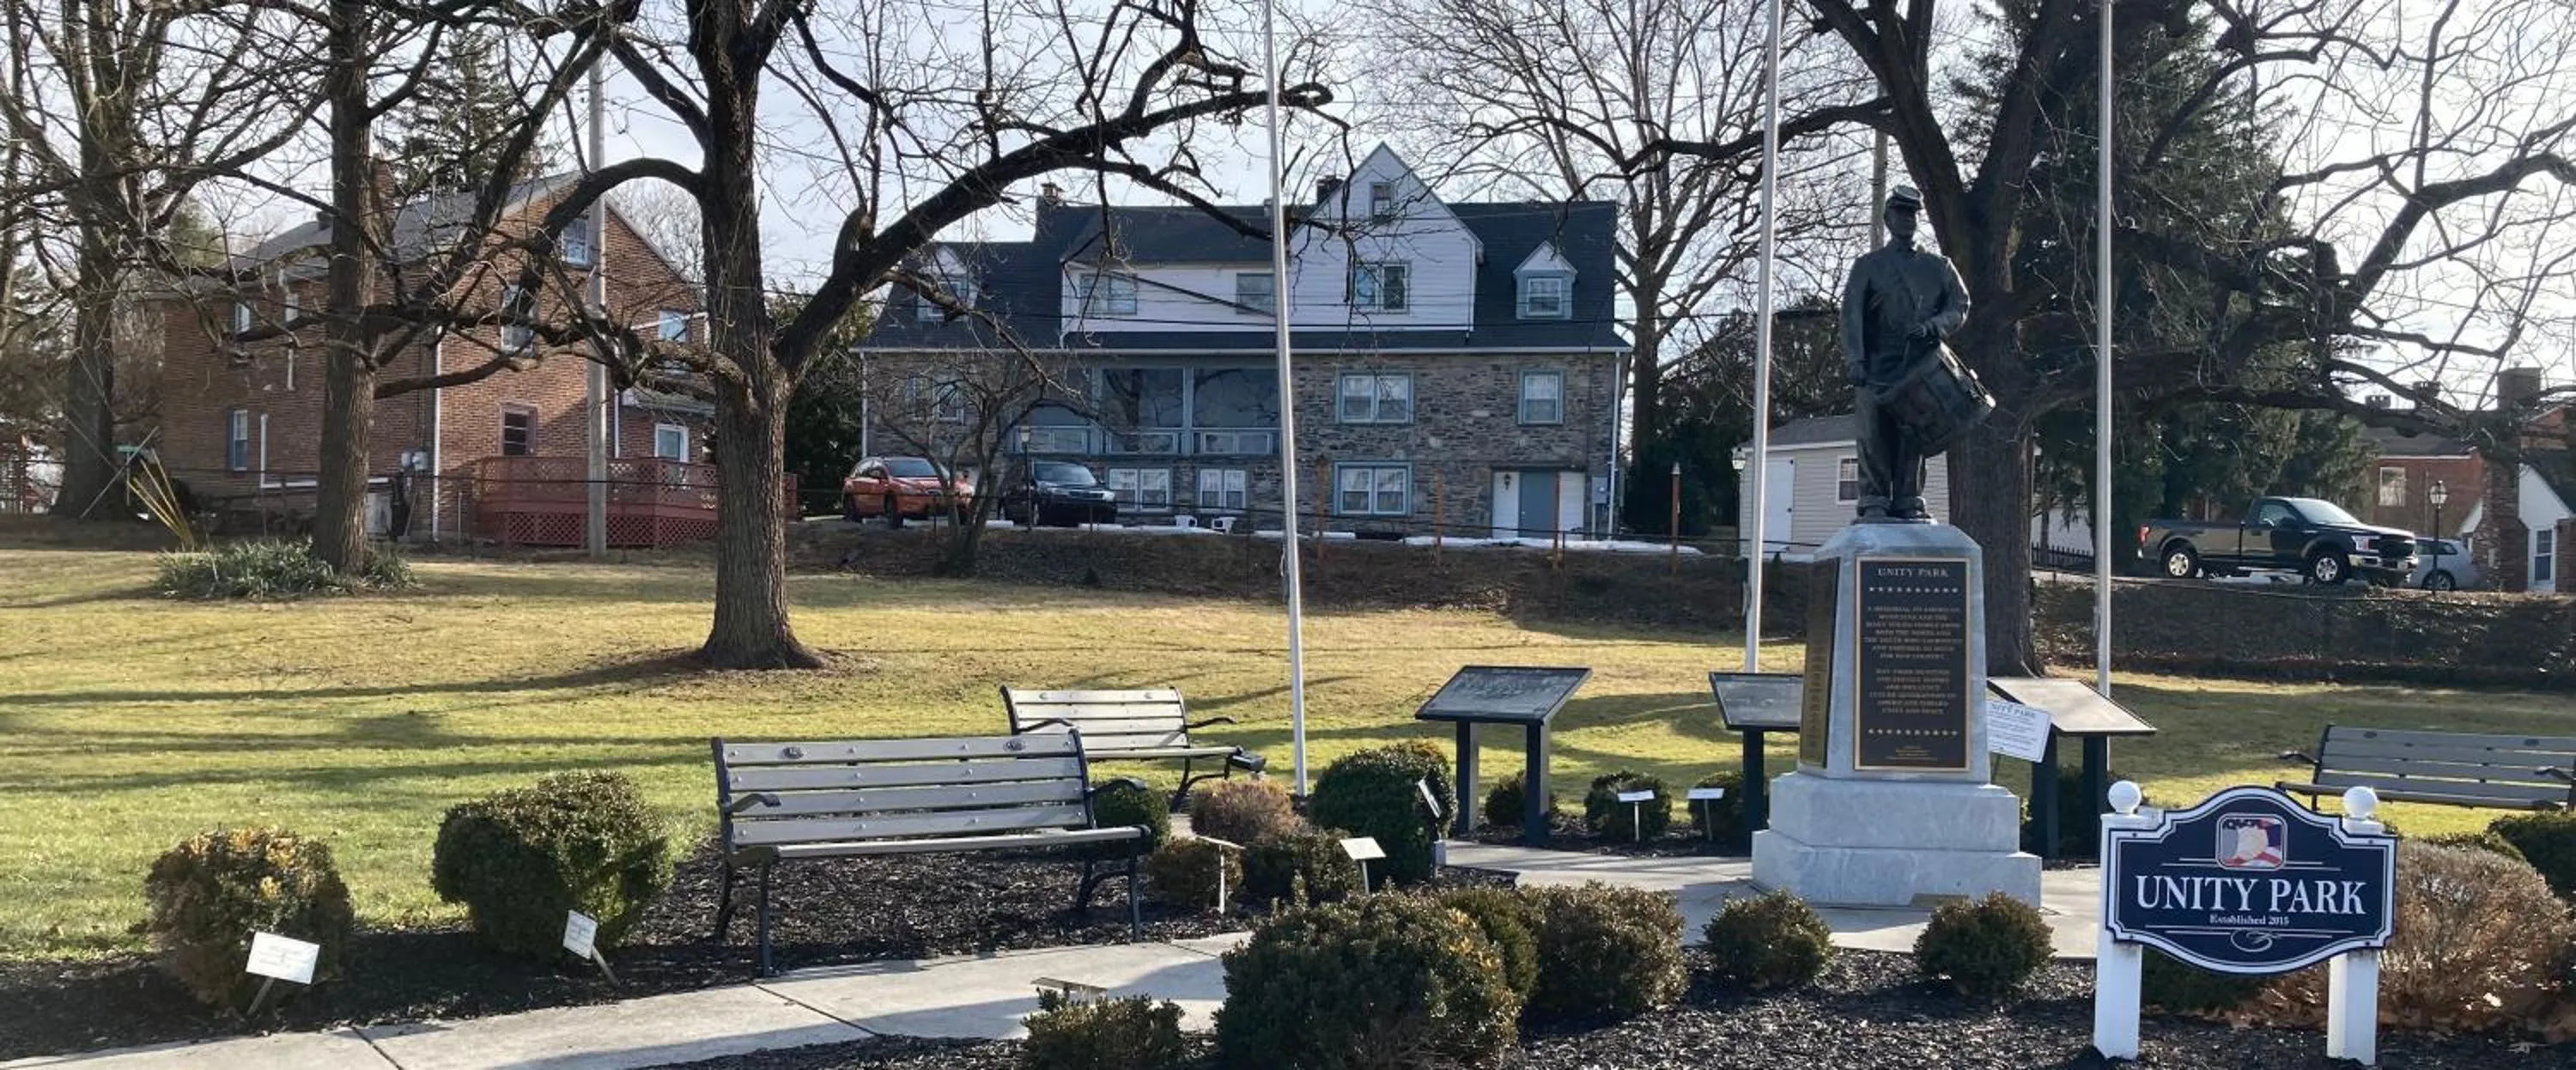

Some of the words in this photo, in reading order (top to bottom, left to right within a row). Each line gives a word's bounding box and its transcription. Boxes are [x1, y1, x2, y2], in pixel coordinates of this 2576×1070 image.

[1877, 568, 1913, 578] UNITY
[1917, 568, 1949, 578] PARK
[2136, 875, 2258, 912] UNITY
[2269, 878, 2367, 915] PARK
[2209, 913, 2266, 925] Established
[2268, 915, 2290, 926] 2015
